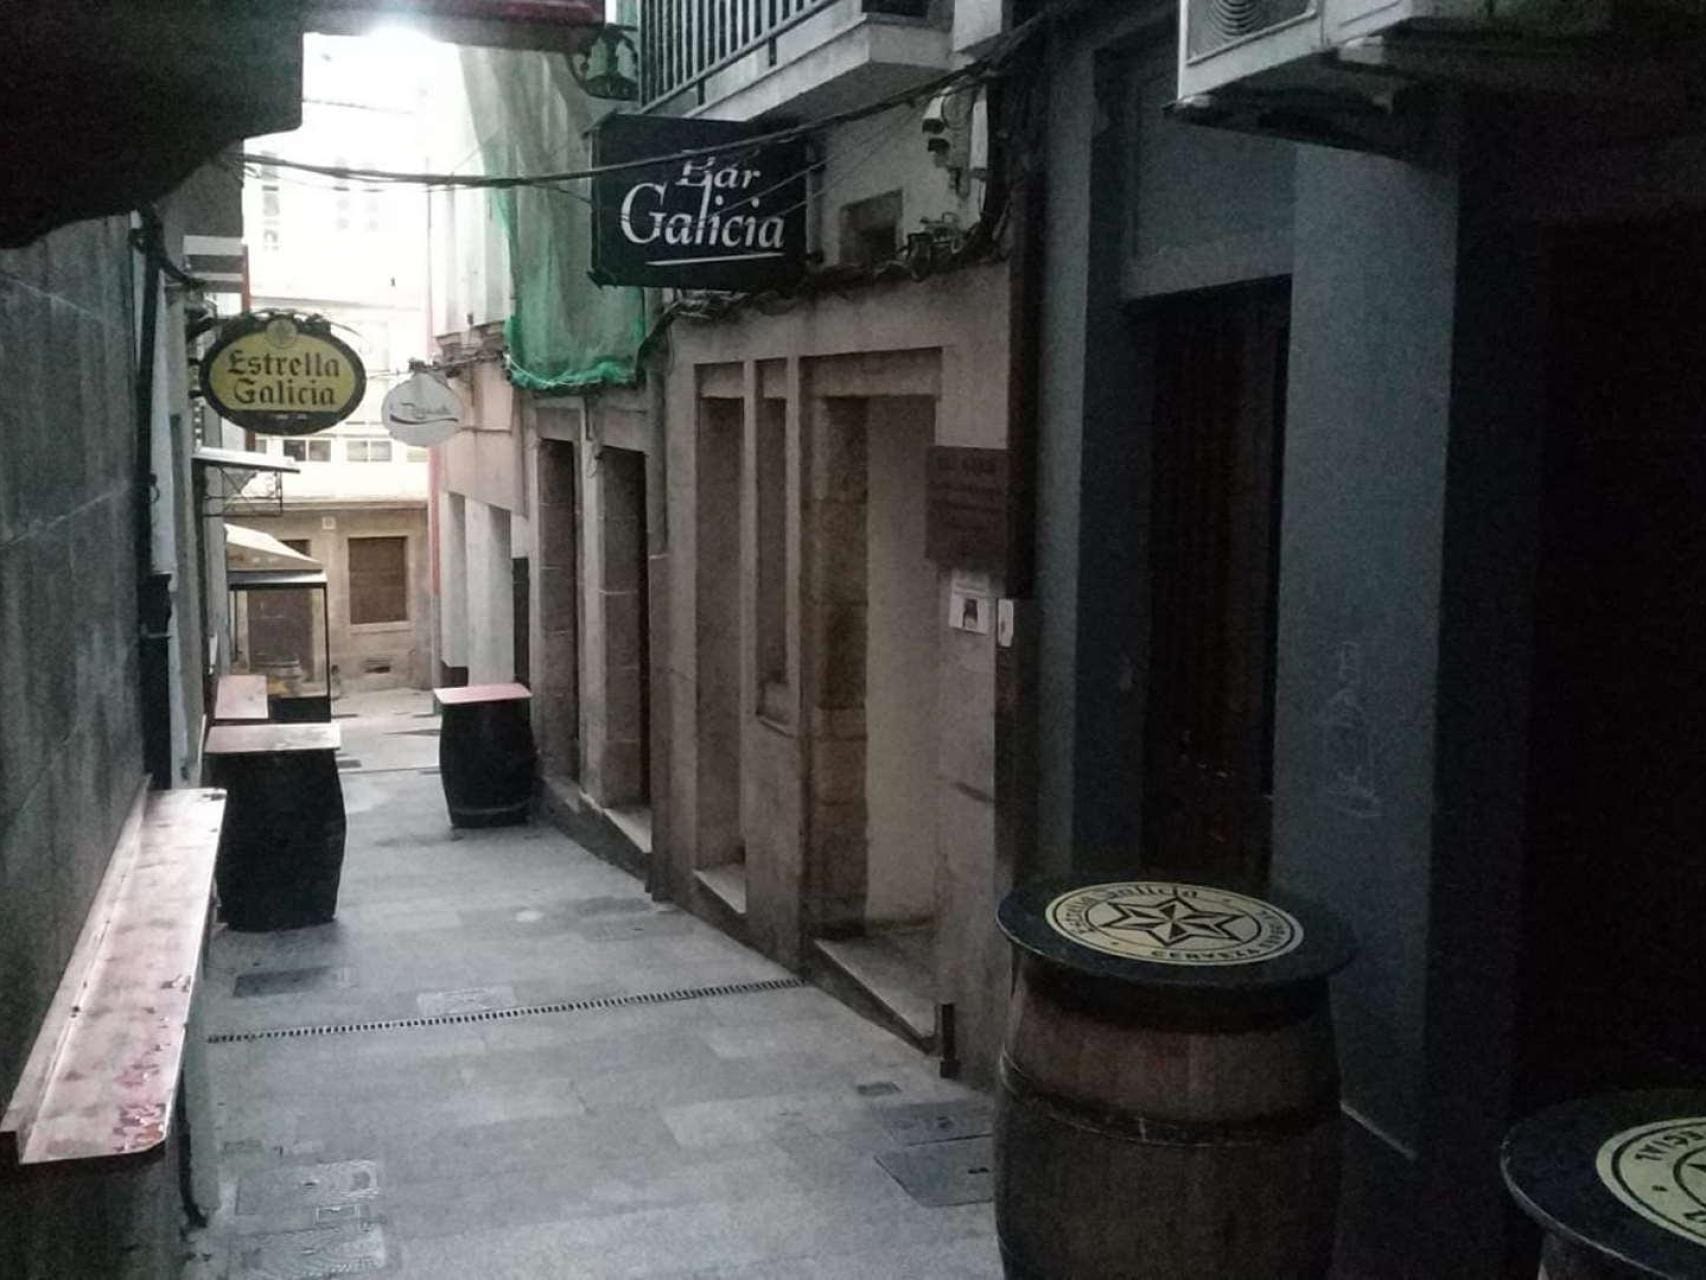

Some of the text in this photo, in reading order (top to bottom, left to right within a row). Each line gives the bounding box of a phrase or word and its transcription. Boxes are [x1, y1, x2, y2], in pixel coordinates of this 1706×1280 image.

[675, 155, 761, 189] Bar
[621, 171, 785, 249] Galicia
[226, 349, 341, 378] Estrella
[233, 378, 337, 406] Galicia
[1634, 1130, 1705, 1161] ECIAL
